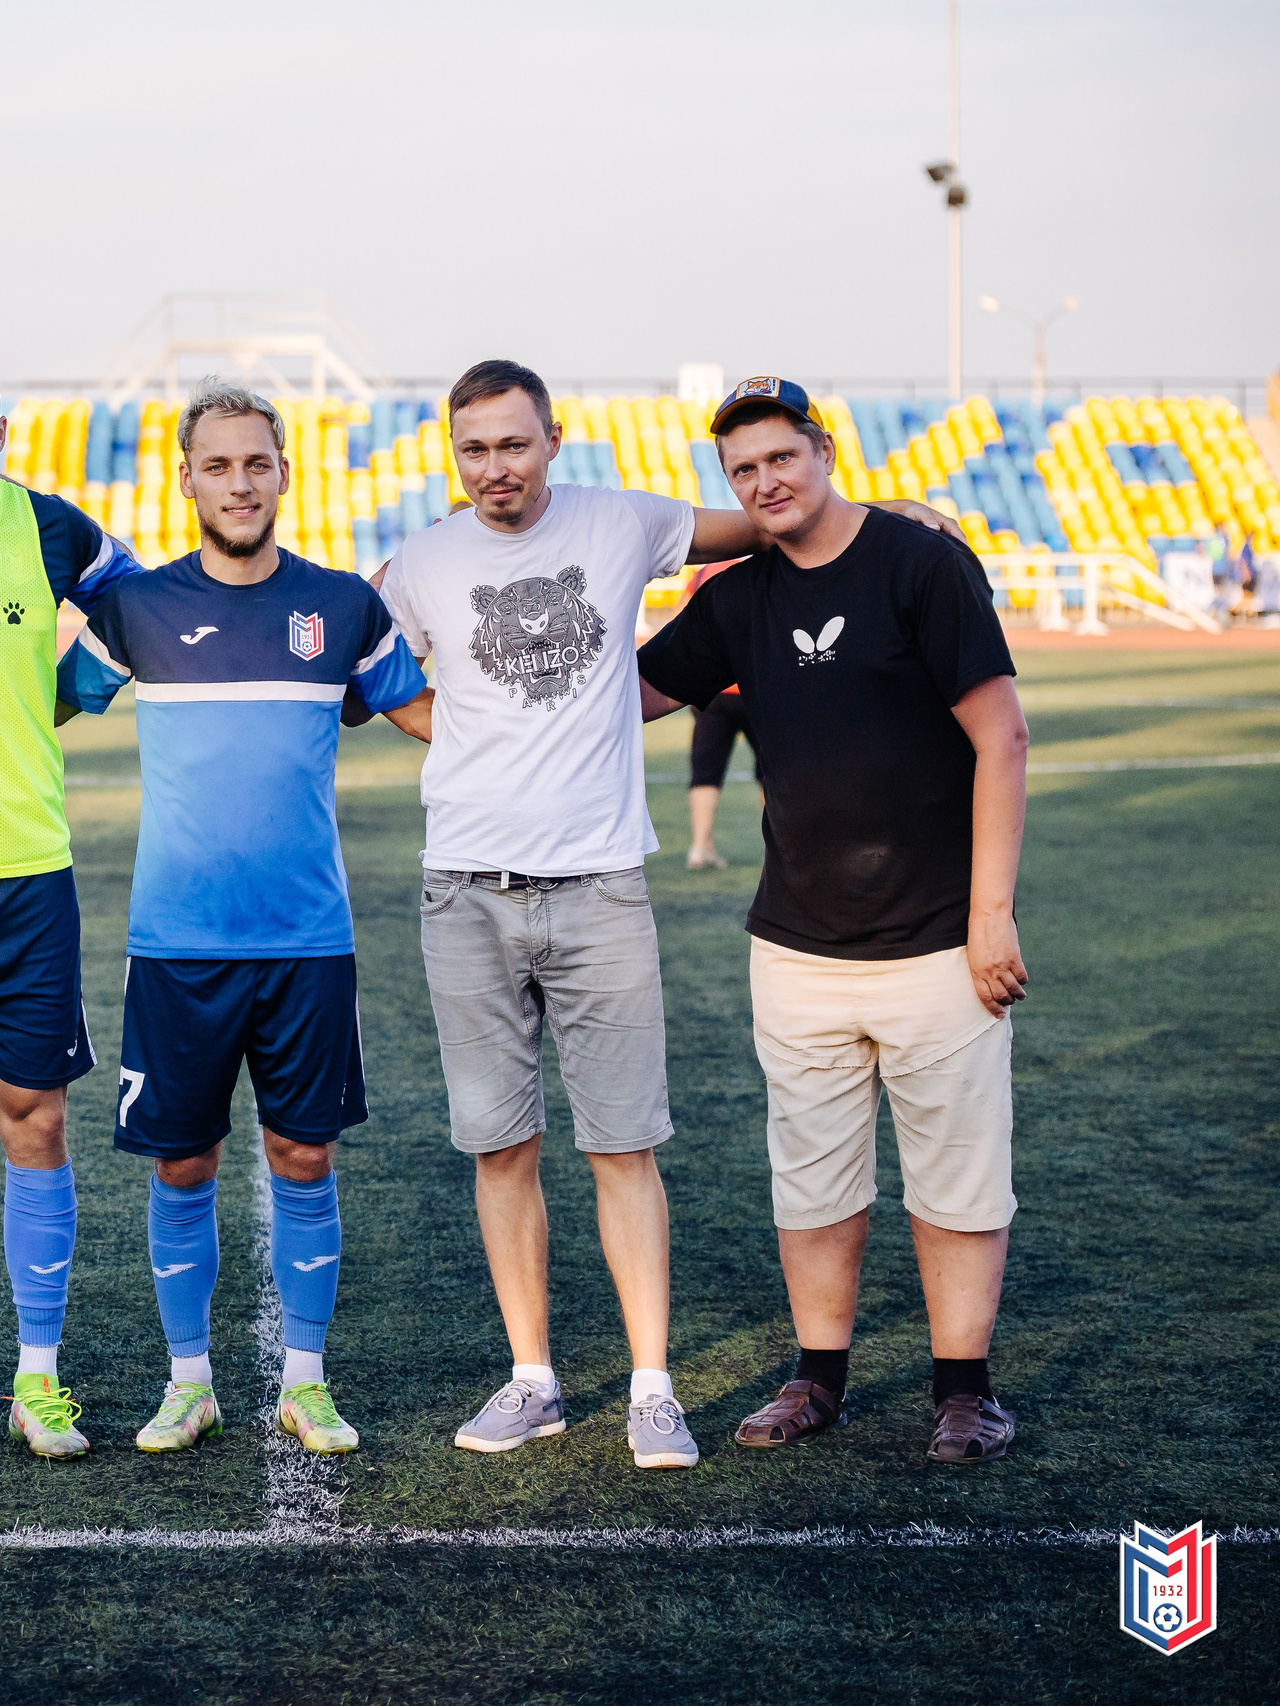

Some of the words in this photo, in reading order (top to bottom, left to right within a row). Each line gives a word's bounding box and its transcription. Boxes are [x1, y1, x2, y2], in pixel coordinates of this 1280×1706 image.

[505, 646, 579, 676] KENZO
[508, 674, 586, 712] PARIS
[118, 1065, 145, 1128] 7
